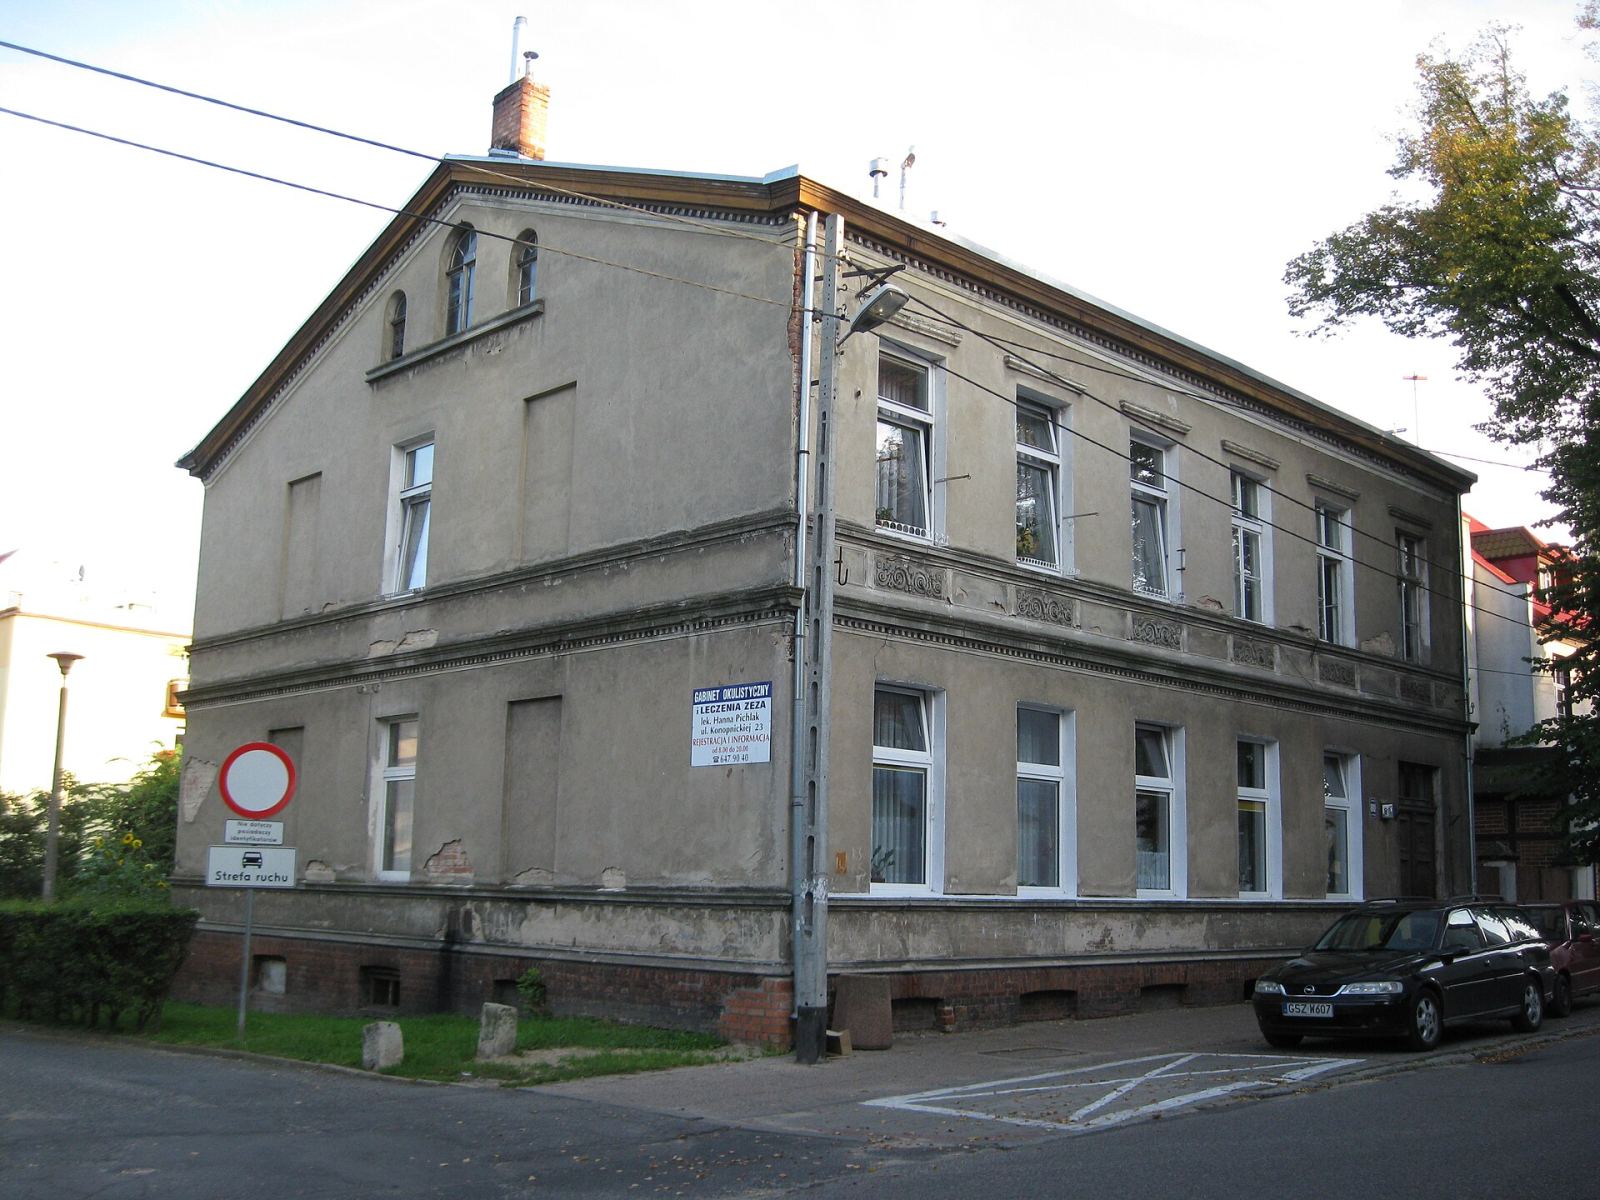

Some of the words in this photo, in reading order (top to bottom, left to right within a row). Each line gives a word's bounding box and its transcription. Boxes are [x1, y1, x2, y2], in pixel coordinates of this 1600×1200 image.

[695, 690, 720, 703] GABINET
[723, 684, 769, 700] OKULISTYCZNY
[700, 703, 741, 714] LECZENIA
[744, 701, 766, 710] ZEZA
[701, 717, 712, 726] lek.
[713, 716, 734, 724] Hanna
[701, 726, 709, 735] ul.
[711, 724, 751, 736] Konopnickiej
[755, 723, 764, 731] 23
[693, 736, 727, 747] REJESTRACJA
[731, 734, 769, 744] INFORMACJA
[741, 753, 749, 762] 40
[215, 871, 251, 881] Strefa
[256, 872, 288, 882] ruchu
[1288, 1004, 1307, 1014] GSZ
[1309, 1004, 1331, 1015] W607
